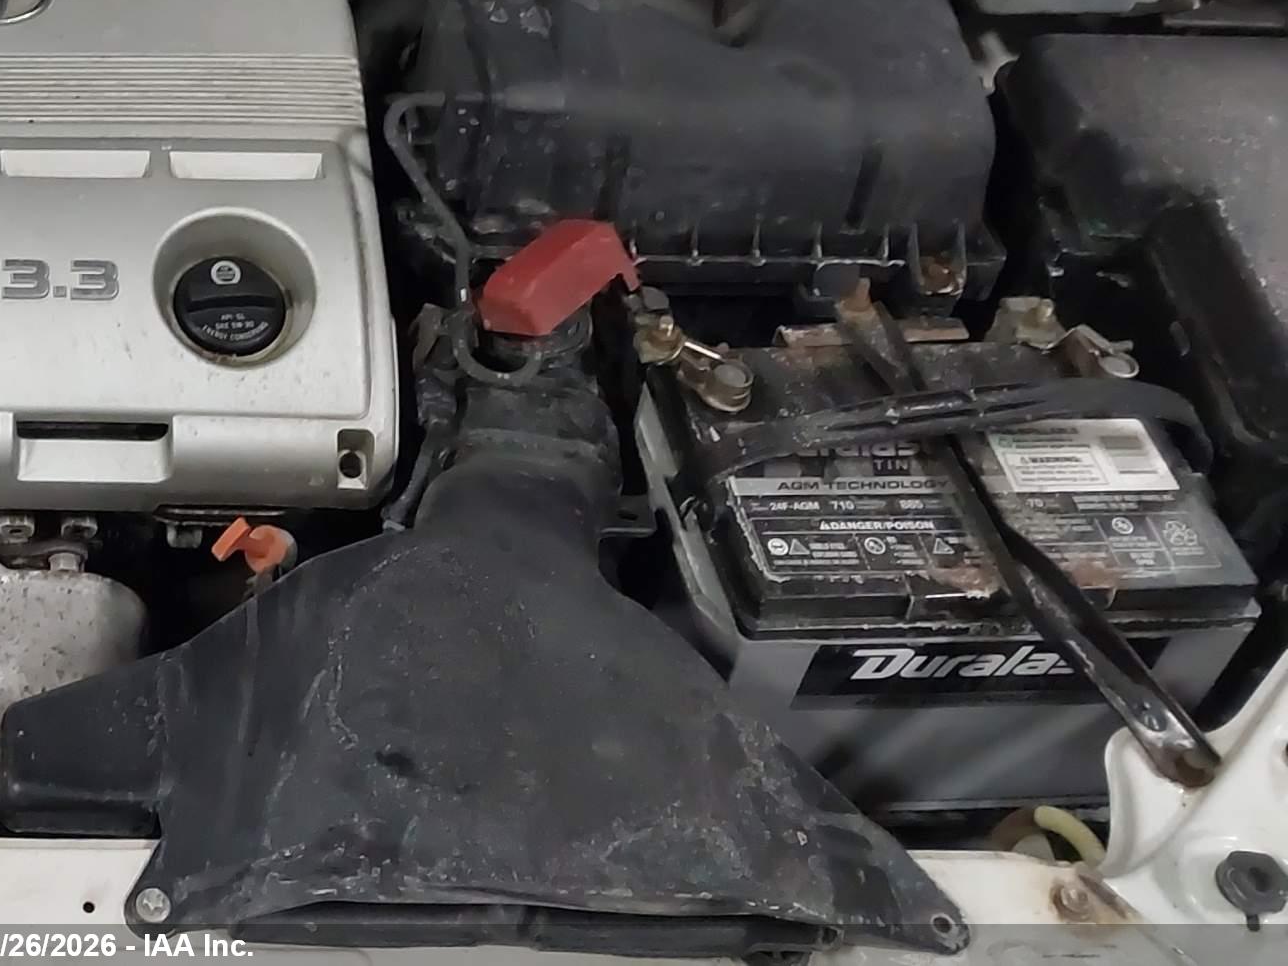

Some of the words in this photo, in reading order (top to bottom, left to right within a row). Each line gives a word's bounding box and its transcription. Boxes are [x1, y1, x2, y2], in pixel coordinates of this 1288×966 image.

[1, 258, 120, 301] 3.3
[777, 480, 820, 491] AGM
[827, 479, 950, 491] TECHNOLOGY
[829, 500, 855, 511] 710
